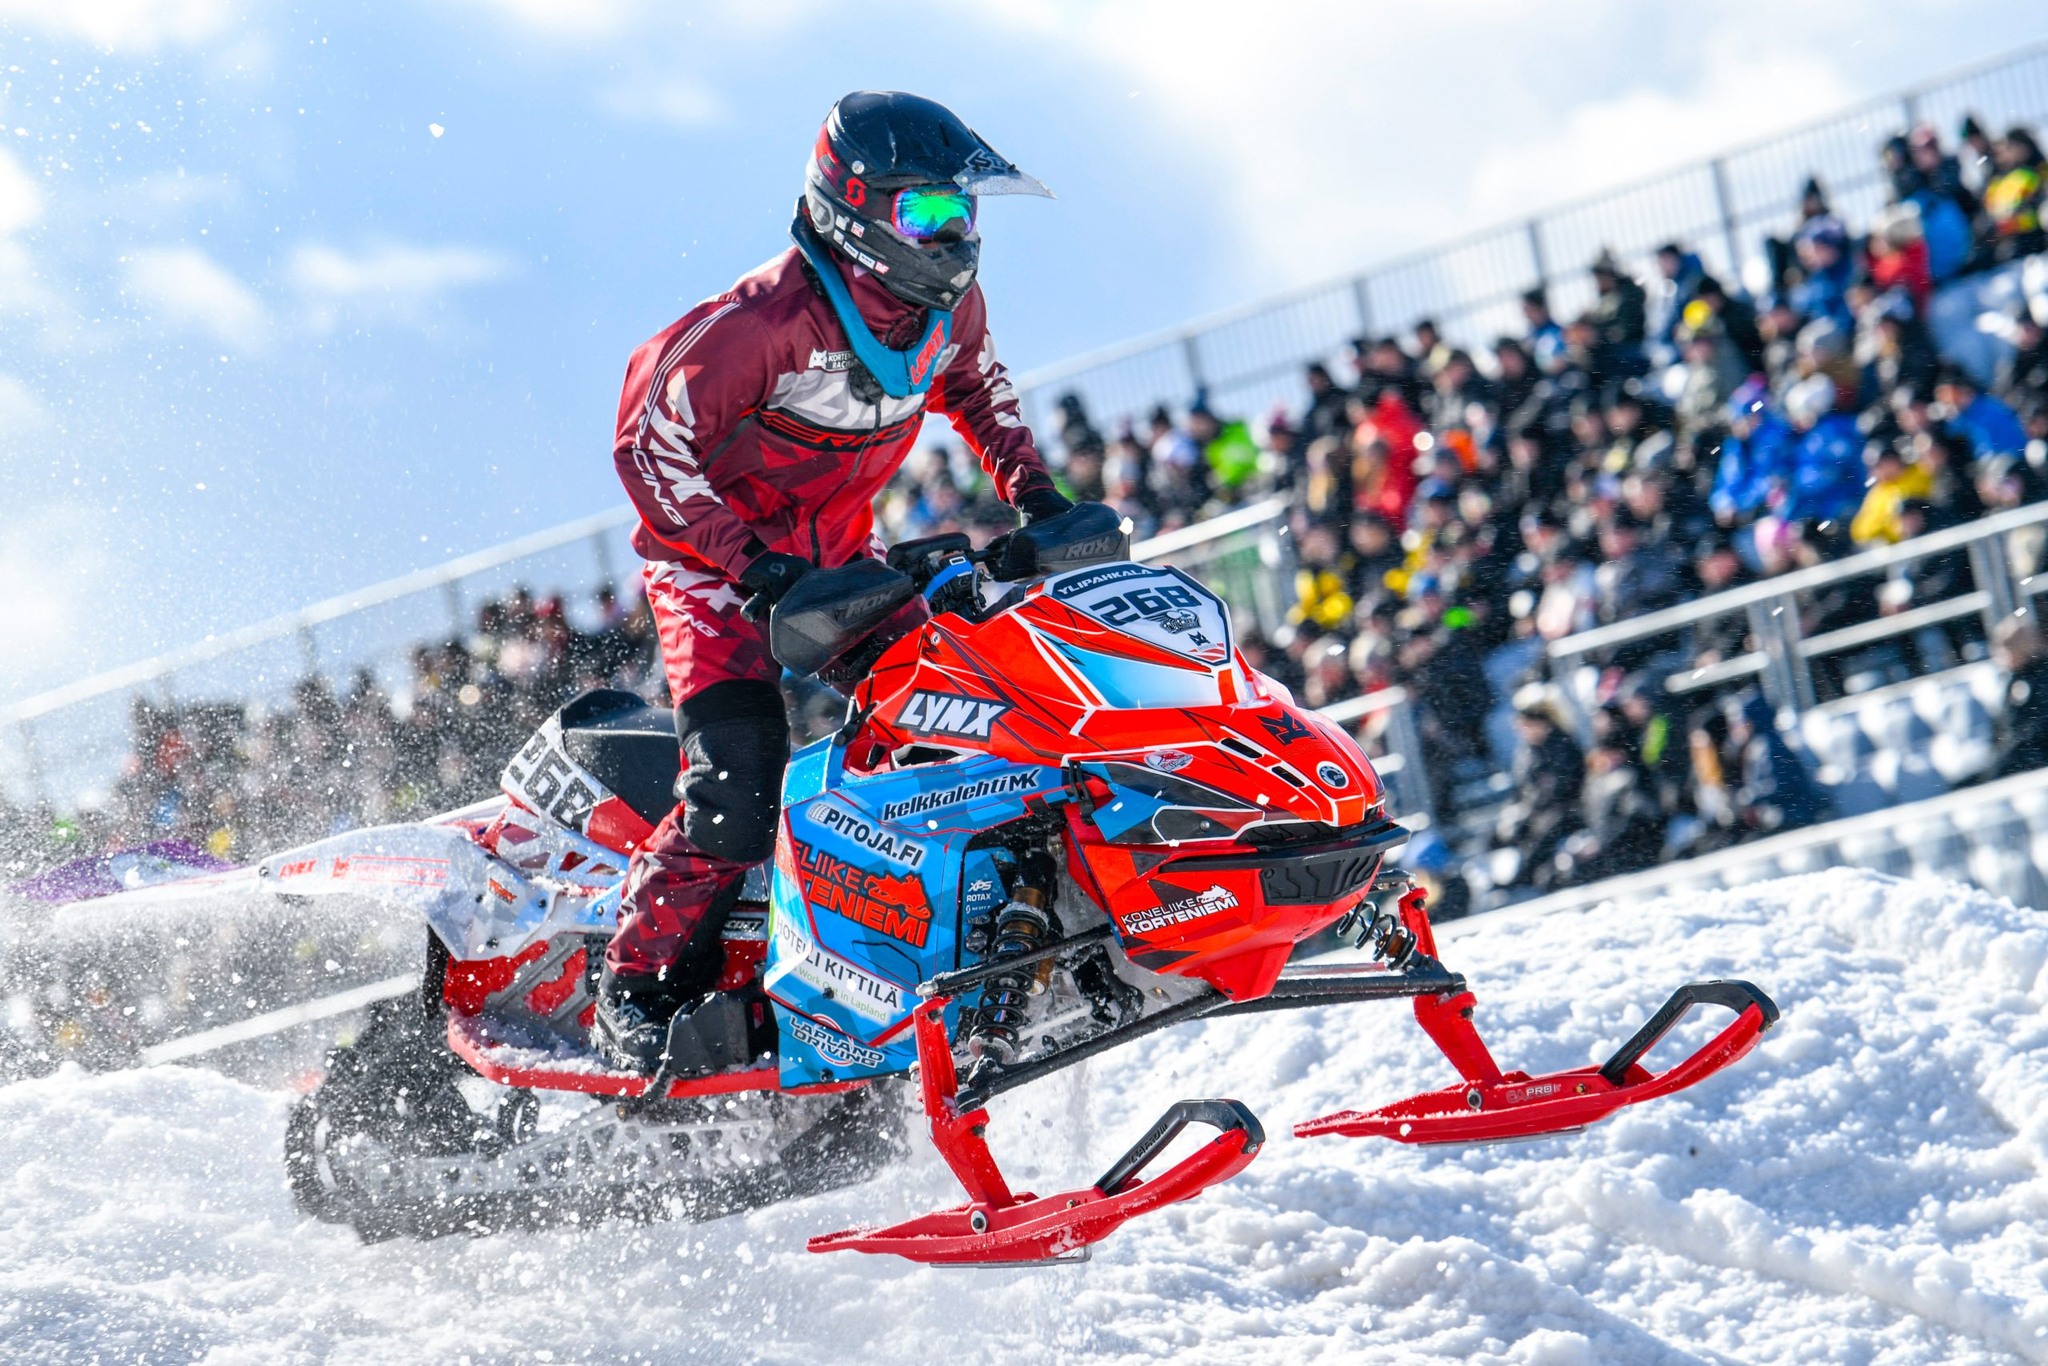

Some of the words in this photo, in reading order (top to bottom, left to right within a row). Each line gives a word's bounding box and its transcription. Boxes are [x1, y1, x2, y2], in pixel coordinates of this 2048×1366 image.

[909, 320, 945, 385] LEATT
[1065, 536, 1110, 559] ROX
[1058, 569, 1153, 595] YLIPAHKALA
[1089, 585, 1202, 626] 268
[899, 693, 1006, 737] LYNX
[508, 731, 598, 834] 268
[823, 808, 923, 867] PITOJA.FI
[966, 893, 992, 903] ROTAX
[968, 879, 993, 892] XPS
[1121, 898, 1197, 924] KONELIIKE
[1126, 896, 1239, 935] KORTENIEMI
[799, 968, 821, 987] Work
[850, 998, 887, 1021] Lapland
[825, 958, 898, 1009] KITTILÄ
[791, 1017, 883, 1061] LAPLAND
[794, 1030, 877, 1066] DRIVING
